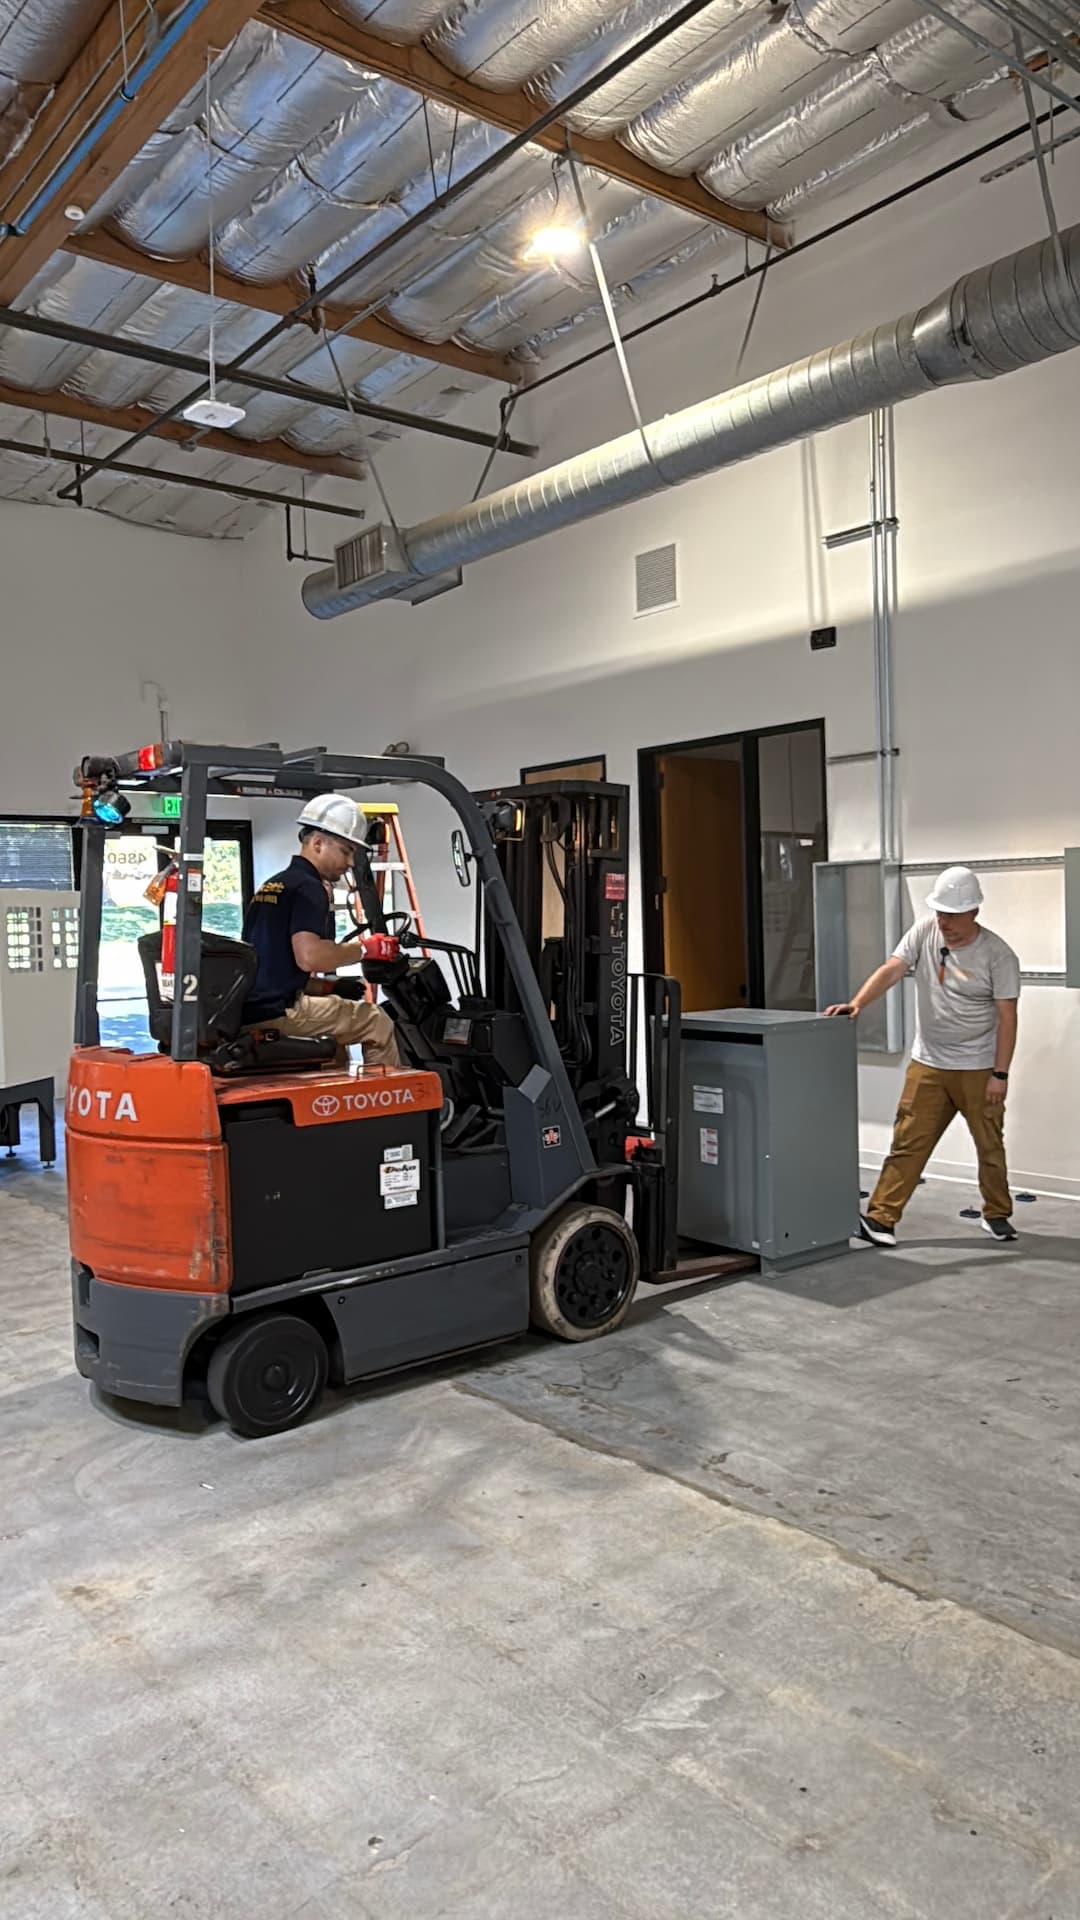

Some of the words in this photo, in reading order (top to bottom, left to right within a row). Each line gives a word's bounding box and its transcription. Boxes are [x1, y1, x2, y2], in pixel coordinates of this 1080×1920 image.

[164, 796, 182, 815] EXI
[183, 974, 198, 1001] 2
[610, 942, 626, 1046] TOYOTA
[342, 1088, 415, 1110] TOYOTA
